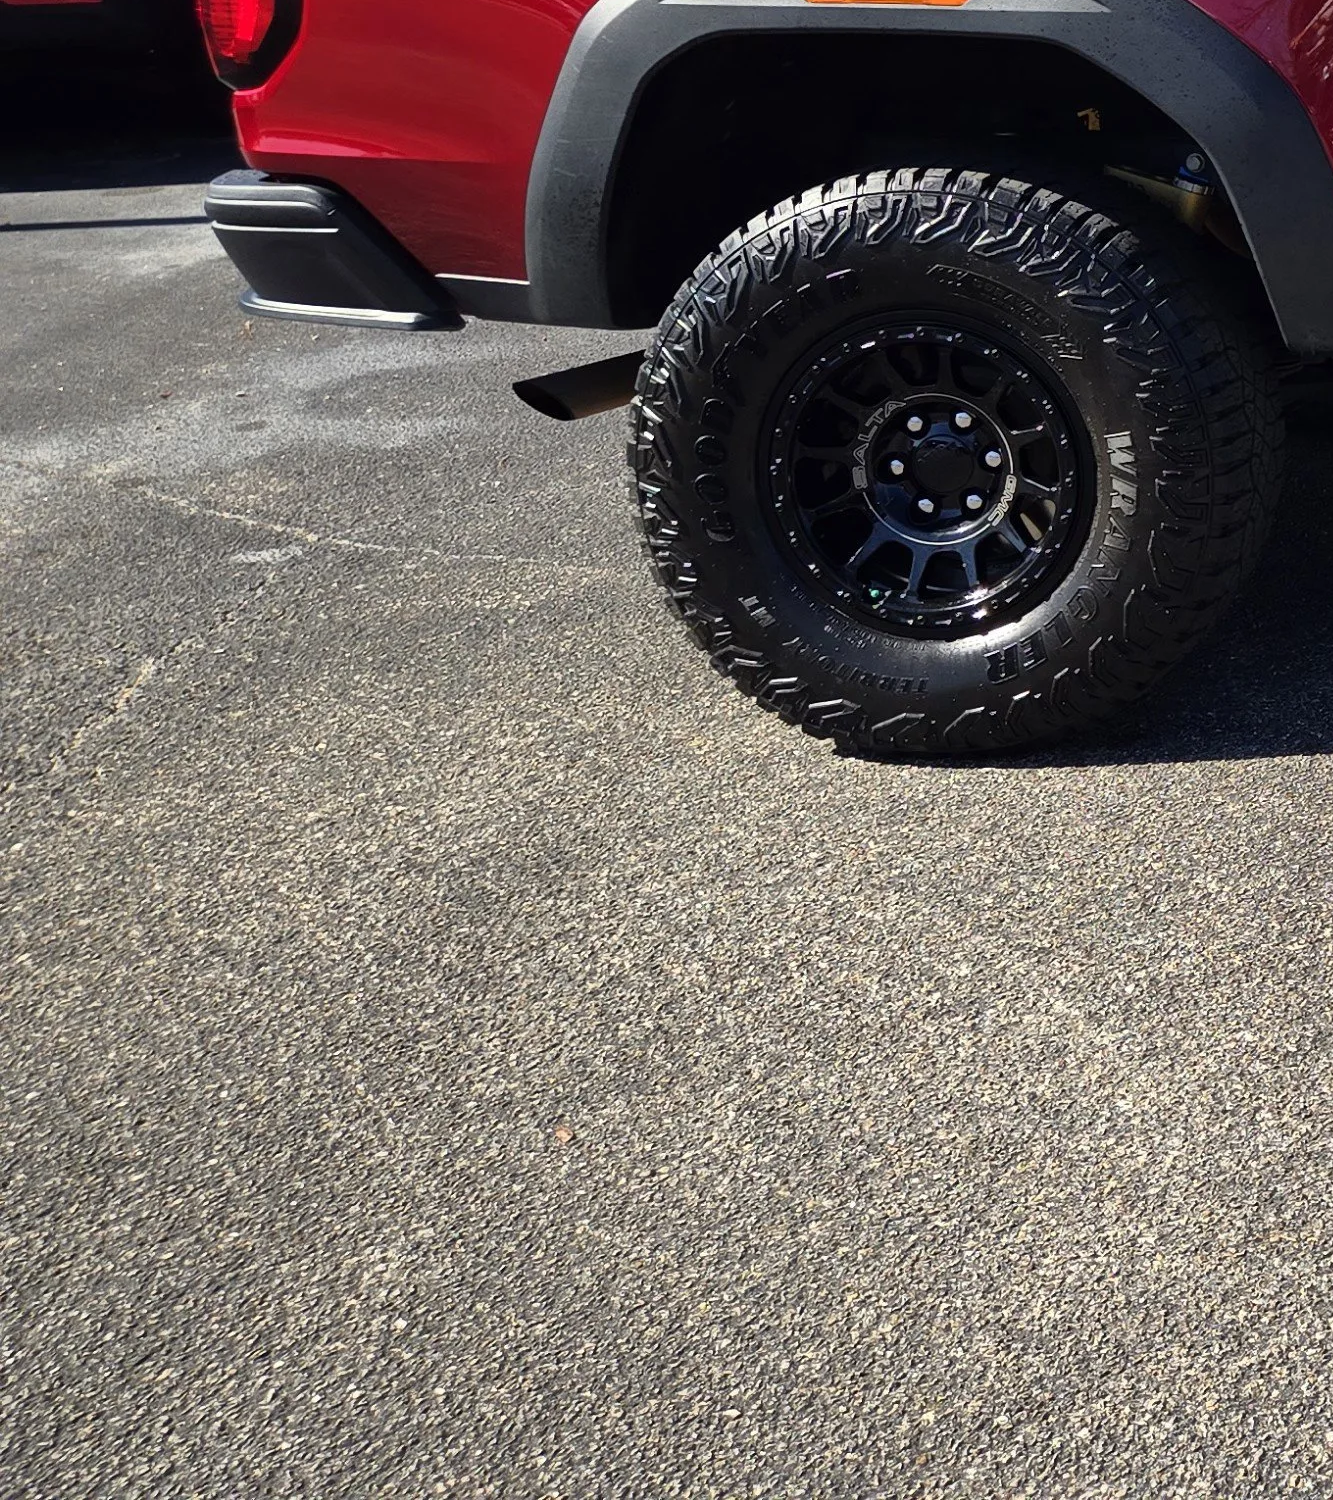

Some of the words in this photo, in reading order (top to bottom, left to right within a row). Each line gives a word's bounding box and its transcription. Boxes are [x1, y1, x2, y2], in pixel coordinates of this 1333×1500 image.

[852, 400, 907, 490] SALTA
[987, 474, 1018, 527] GMC
[983, 430, 1139, 686] WRANGLER
